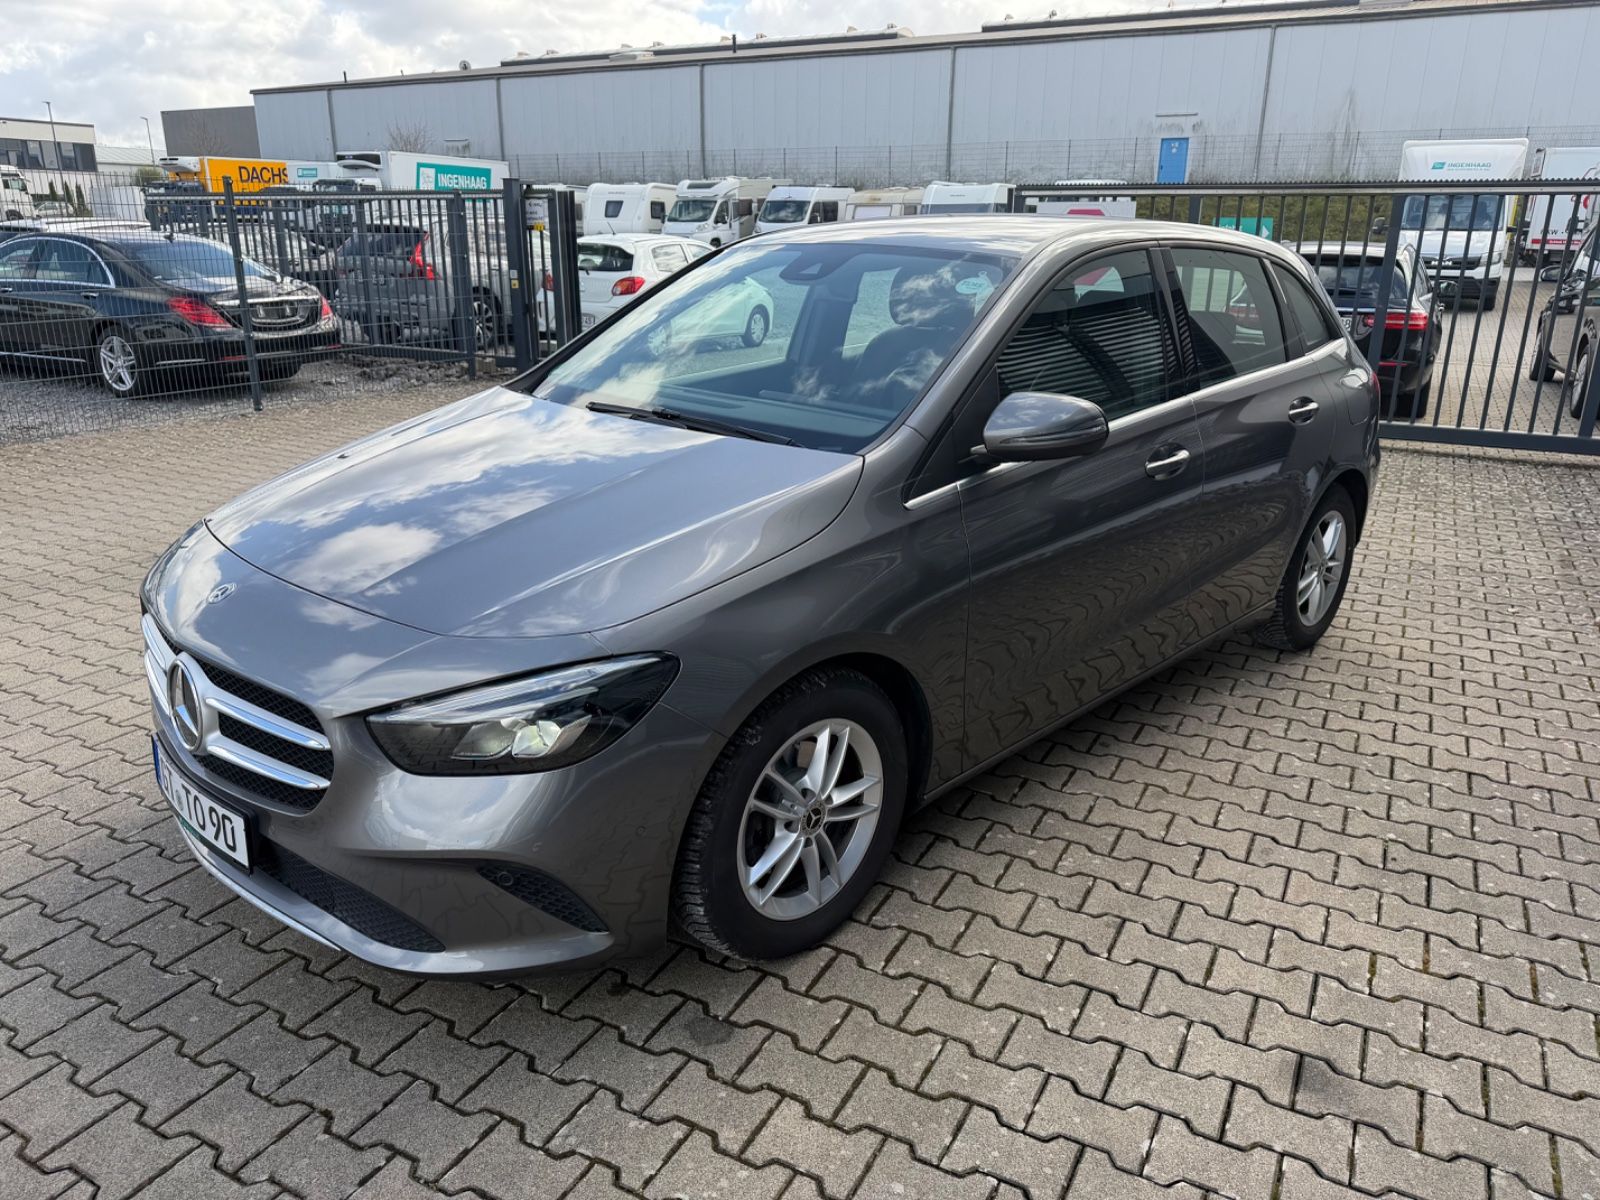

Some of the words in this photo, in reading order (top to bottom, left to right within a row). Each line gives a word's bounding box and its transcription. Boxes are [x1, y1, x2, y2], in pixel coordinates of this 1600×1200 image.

[437, 173, 487, 190] INGENHAAG
[181, 783, 206, 831] TO
[209, 806, 237, 853] 90
